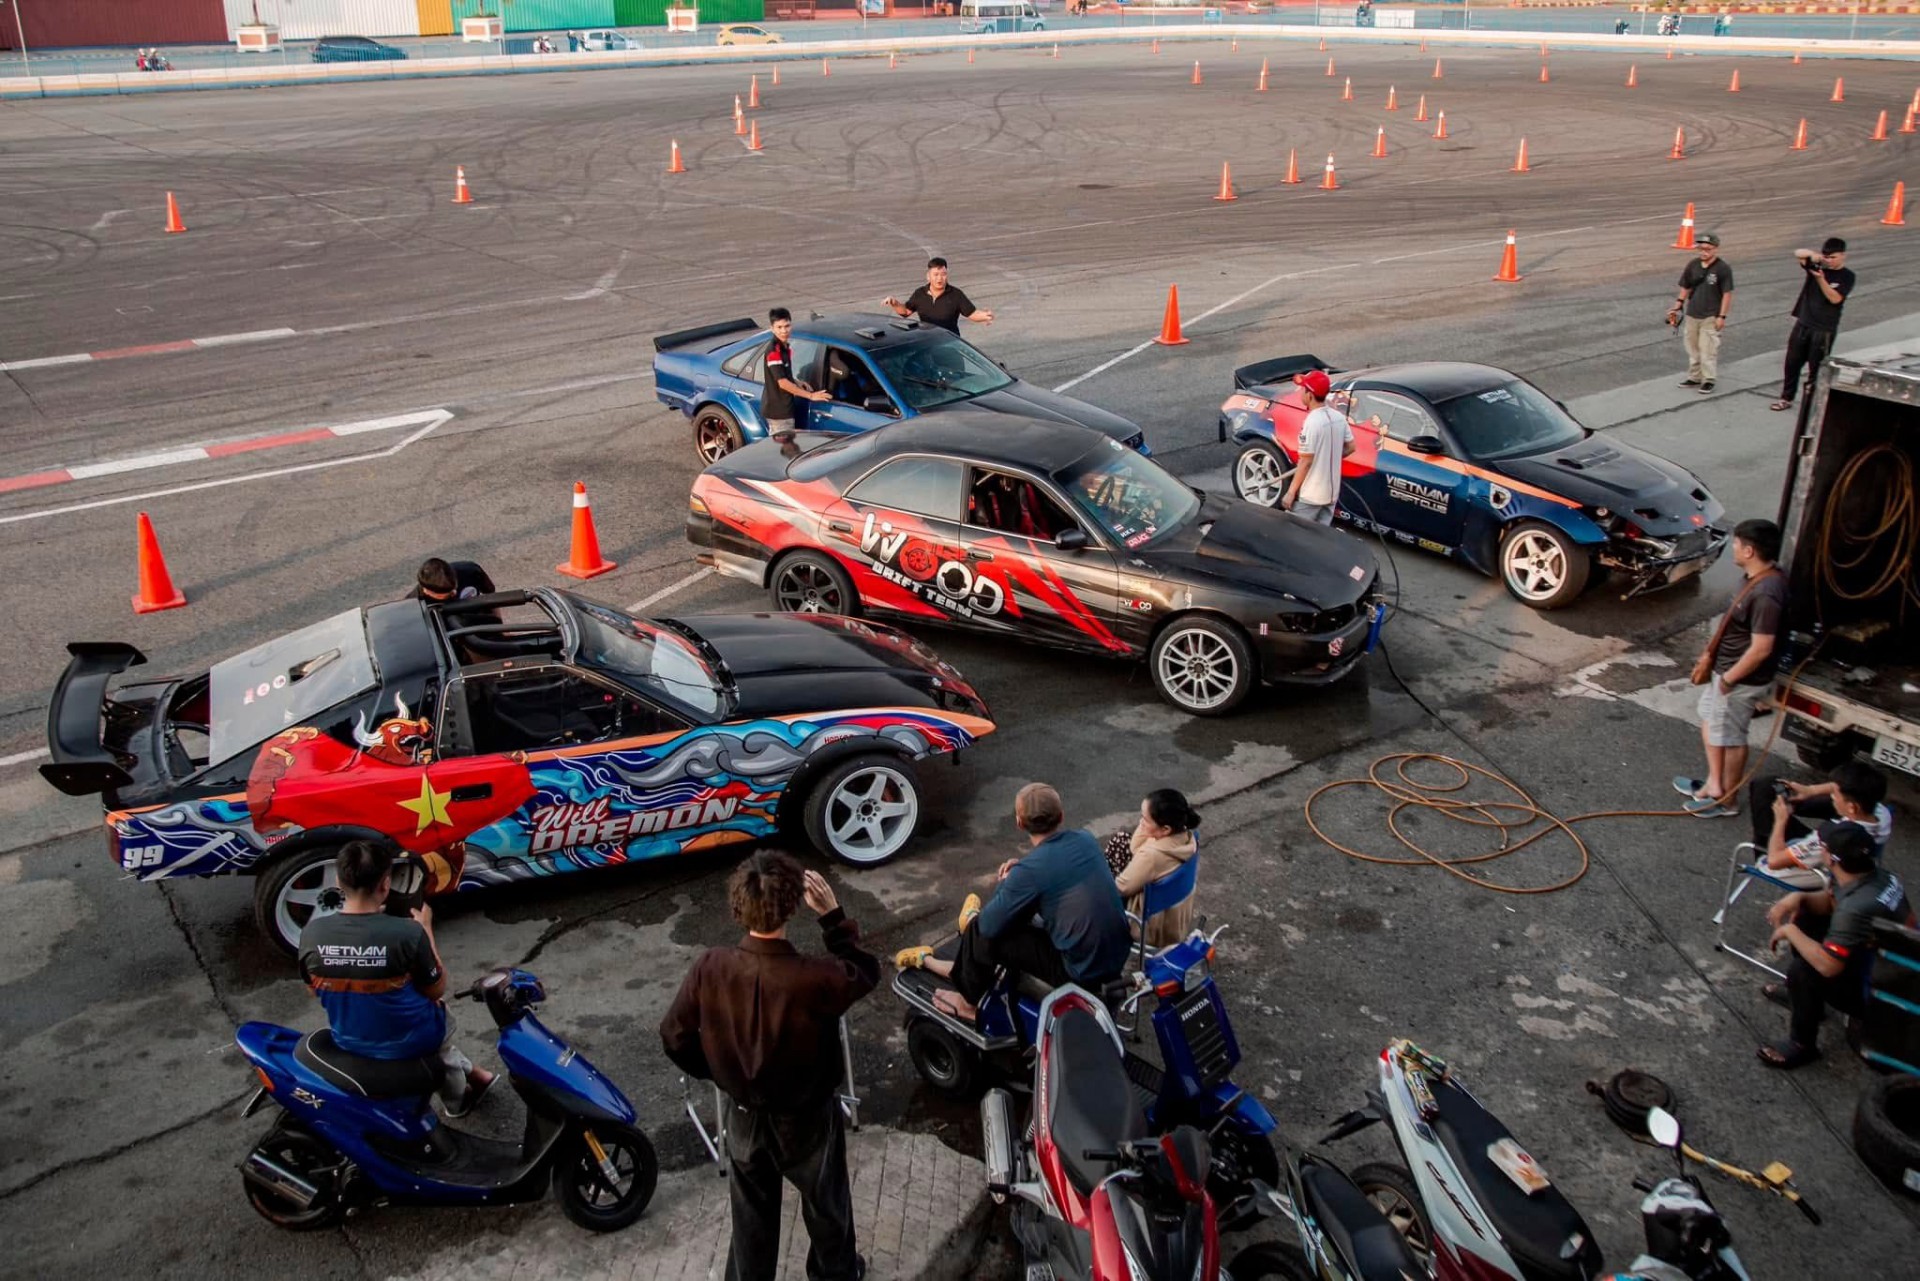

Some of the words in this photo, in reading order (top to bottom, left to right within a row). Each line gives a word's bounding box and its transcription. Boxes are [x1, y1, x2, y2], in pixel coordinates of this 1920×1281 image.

[1385, 473, 1450, 503] VIETNAM
[1389, 489, 1419, 506] DRIFT
[1420, 498, 1448, 515] CLUB
[871, 560, 923, 594] DRIFT
[925, 587, 973, 618] TEAM
[530, 796, 737, 854] DAEMON
[532, 797, 609, 834] Will
[123, 844, 165, 871] 99
[317, 944, 387, 956] VIETNAM
[323, 958, 357, 966] DRIFT
[357, 958, 387, 967] CLUB
[1181, 998, 1210, 1022] HONDA
